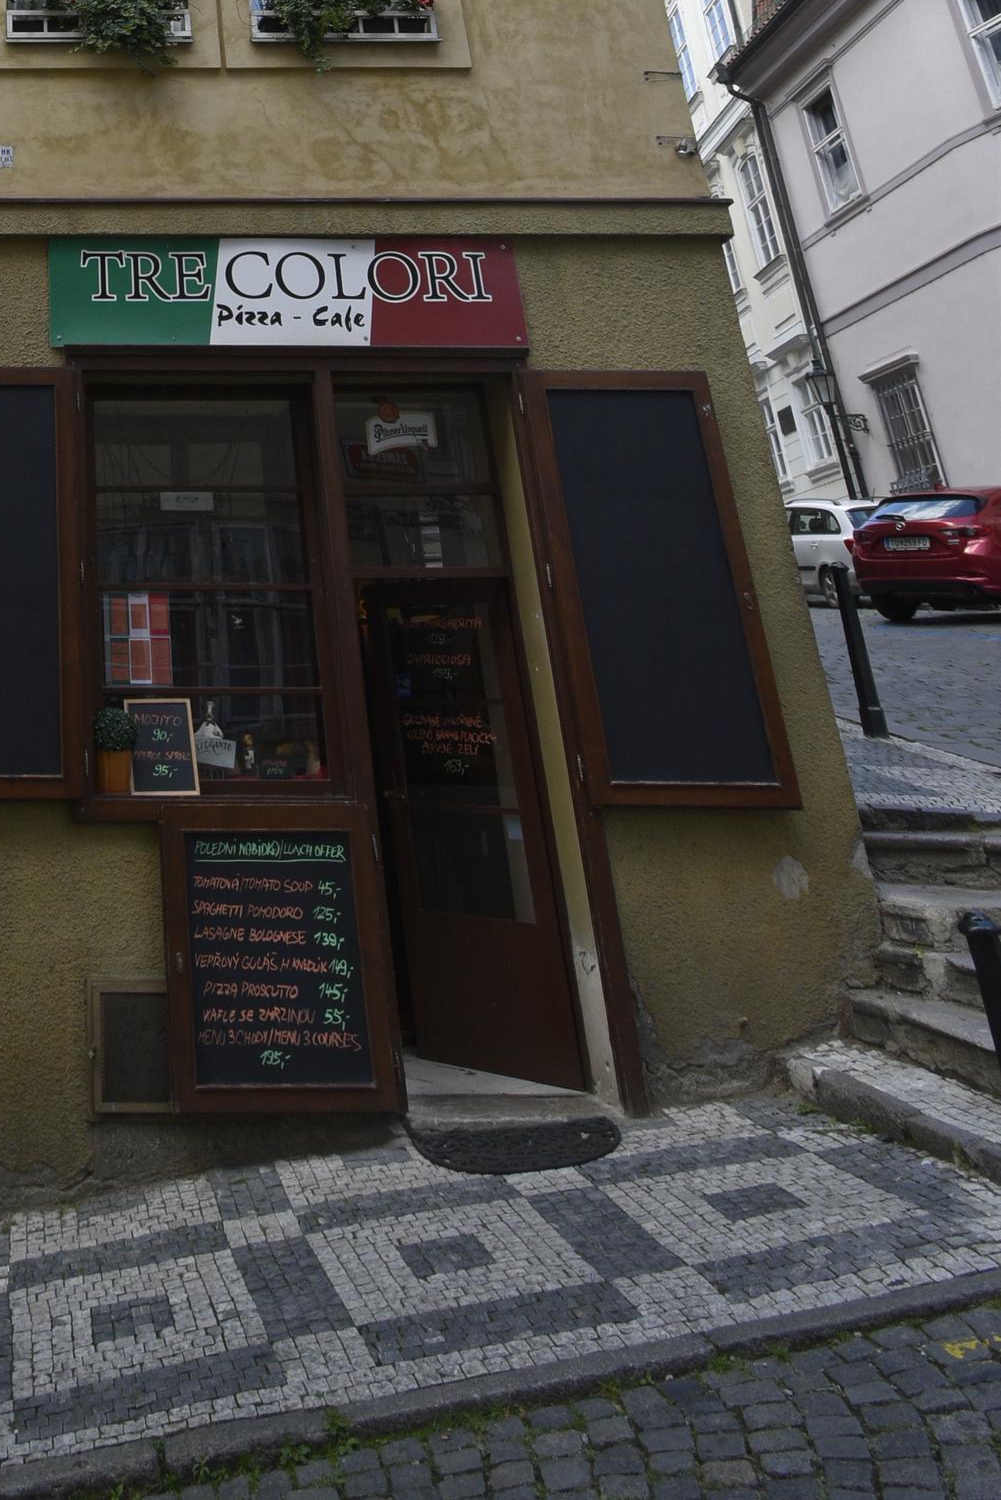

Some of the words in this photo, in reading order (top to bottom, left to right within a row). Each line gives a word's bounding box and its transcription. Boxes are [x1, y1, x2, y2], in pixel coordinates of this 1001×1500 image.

[80, 250, 212, 302] TRE
[224, 250, 493, 302] COLORI
[216, 303, 283, 328] Pizza
[313, 304, 366, 332] Cafe
[134, 713, 183, 726] MOJITO
[314, 844, 346, 861] OFFER
[283, 879, 313, 893] SOUP
[192, 899, 243, 918] SPAGHETTI
[247, 904, 304, 920] POMODORO
[194, 925, 245, 942] LASAGNE
[249, 927, 307, 945] BOLOGNESE
[194, 951, 240, 971] VEPŘOVÝ
[202, 981, 238, 998] PIZZA
[238, 1009, 254, 1022] SE
